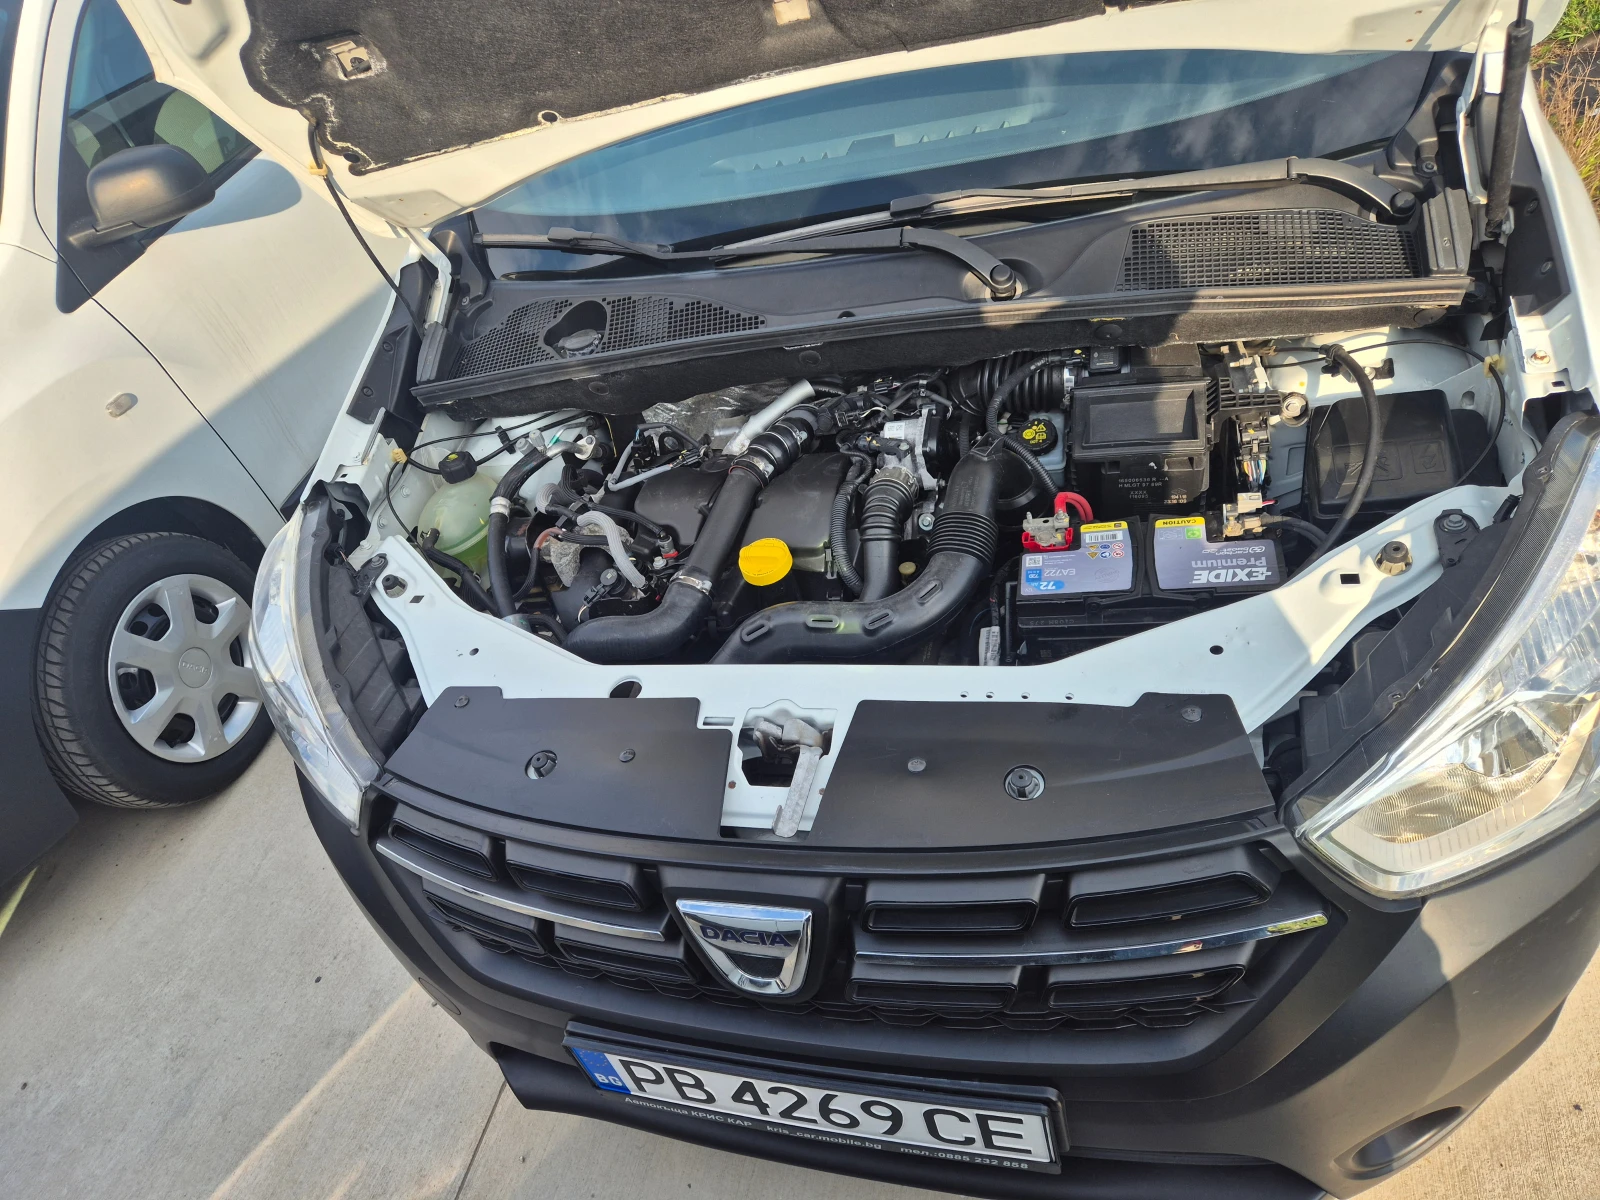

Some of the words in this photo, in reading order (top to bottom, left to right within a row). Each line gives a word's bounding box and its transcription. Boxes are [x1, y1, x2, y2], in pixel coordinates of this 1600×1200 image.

[1191, 557, 1267, 568] Premium
[1044, 568, 1076, 577] EA722
[1192, 567, 1271, 583] EXIDE
[1039, 581, 1056, 590] 72
[699, 924, 793, 947] DACIA
[593, 1072, 623, 1087] BG
[618, 1058, 717, 1105] PB
[730, 1079, 904, 1136] 4269
[922, 1107, 1033, 1155] CE
[624, 1097, 689, 1116] Автокъща
[691, 1110, 725, 1123] КРИС
[727, 1117, 753, 1127] КАР
[766, 1124, 882, 1151] kris_car.mobile.bg
[974, 1156, 999, 1166] 232
[1002, 1160, 1029, 1170] 858
